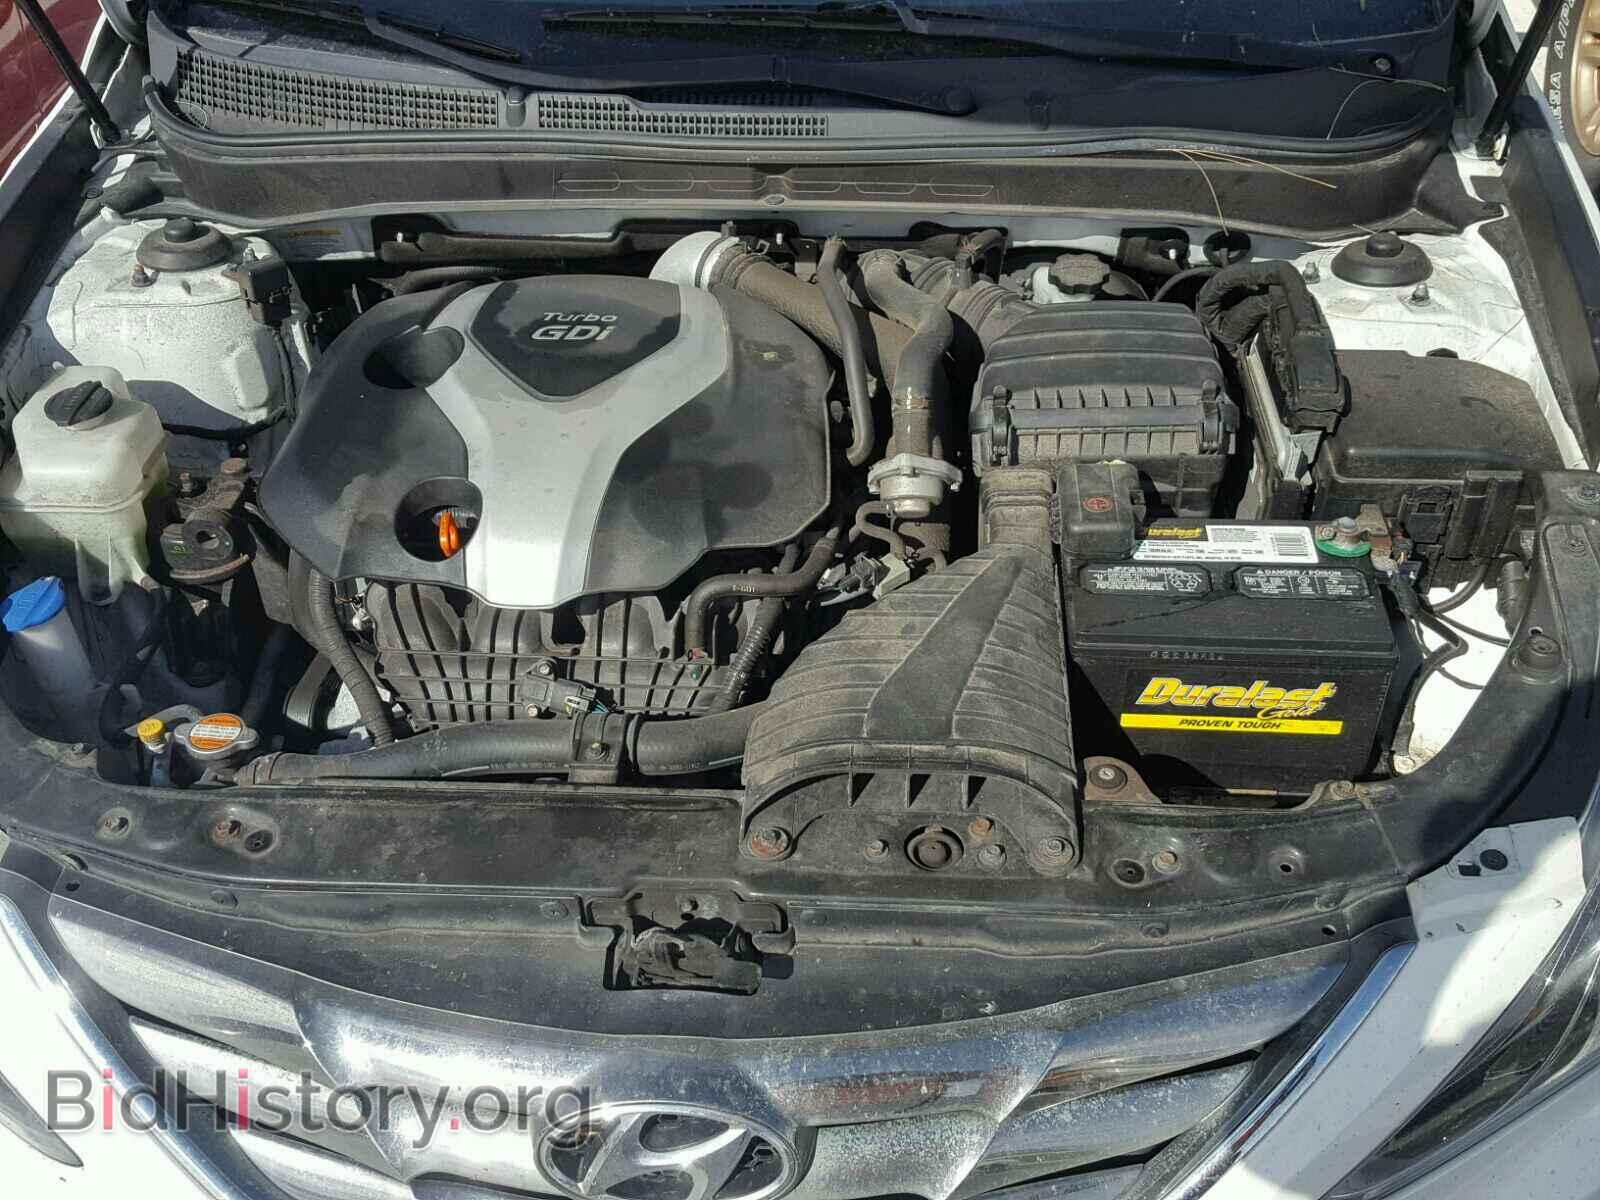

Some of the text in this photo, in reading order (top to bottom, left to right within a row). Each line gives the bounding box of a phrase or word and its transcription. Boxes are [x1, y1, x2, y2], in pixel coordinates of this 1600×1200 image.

[543, 311, 618, 322] Turbo
[531, 325, 617, 341] GDi
[1136, 677, 1337, 710] Duralast
[1178, 719, 1282, 730] PROVEN TOUGH
